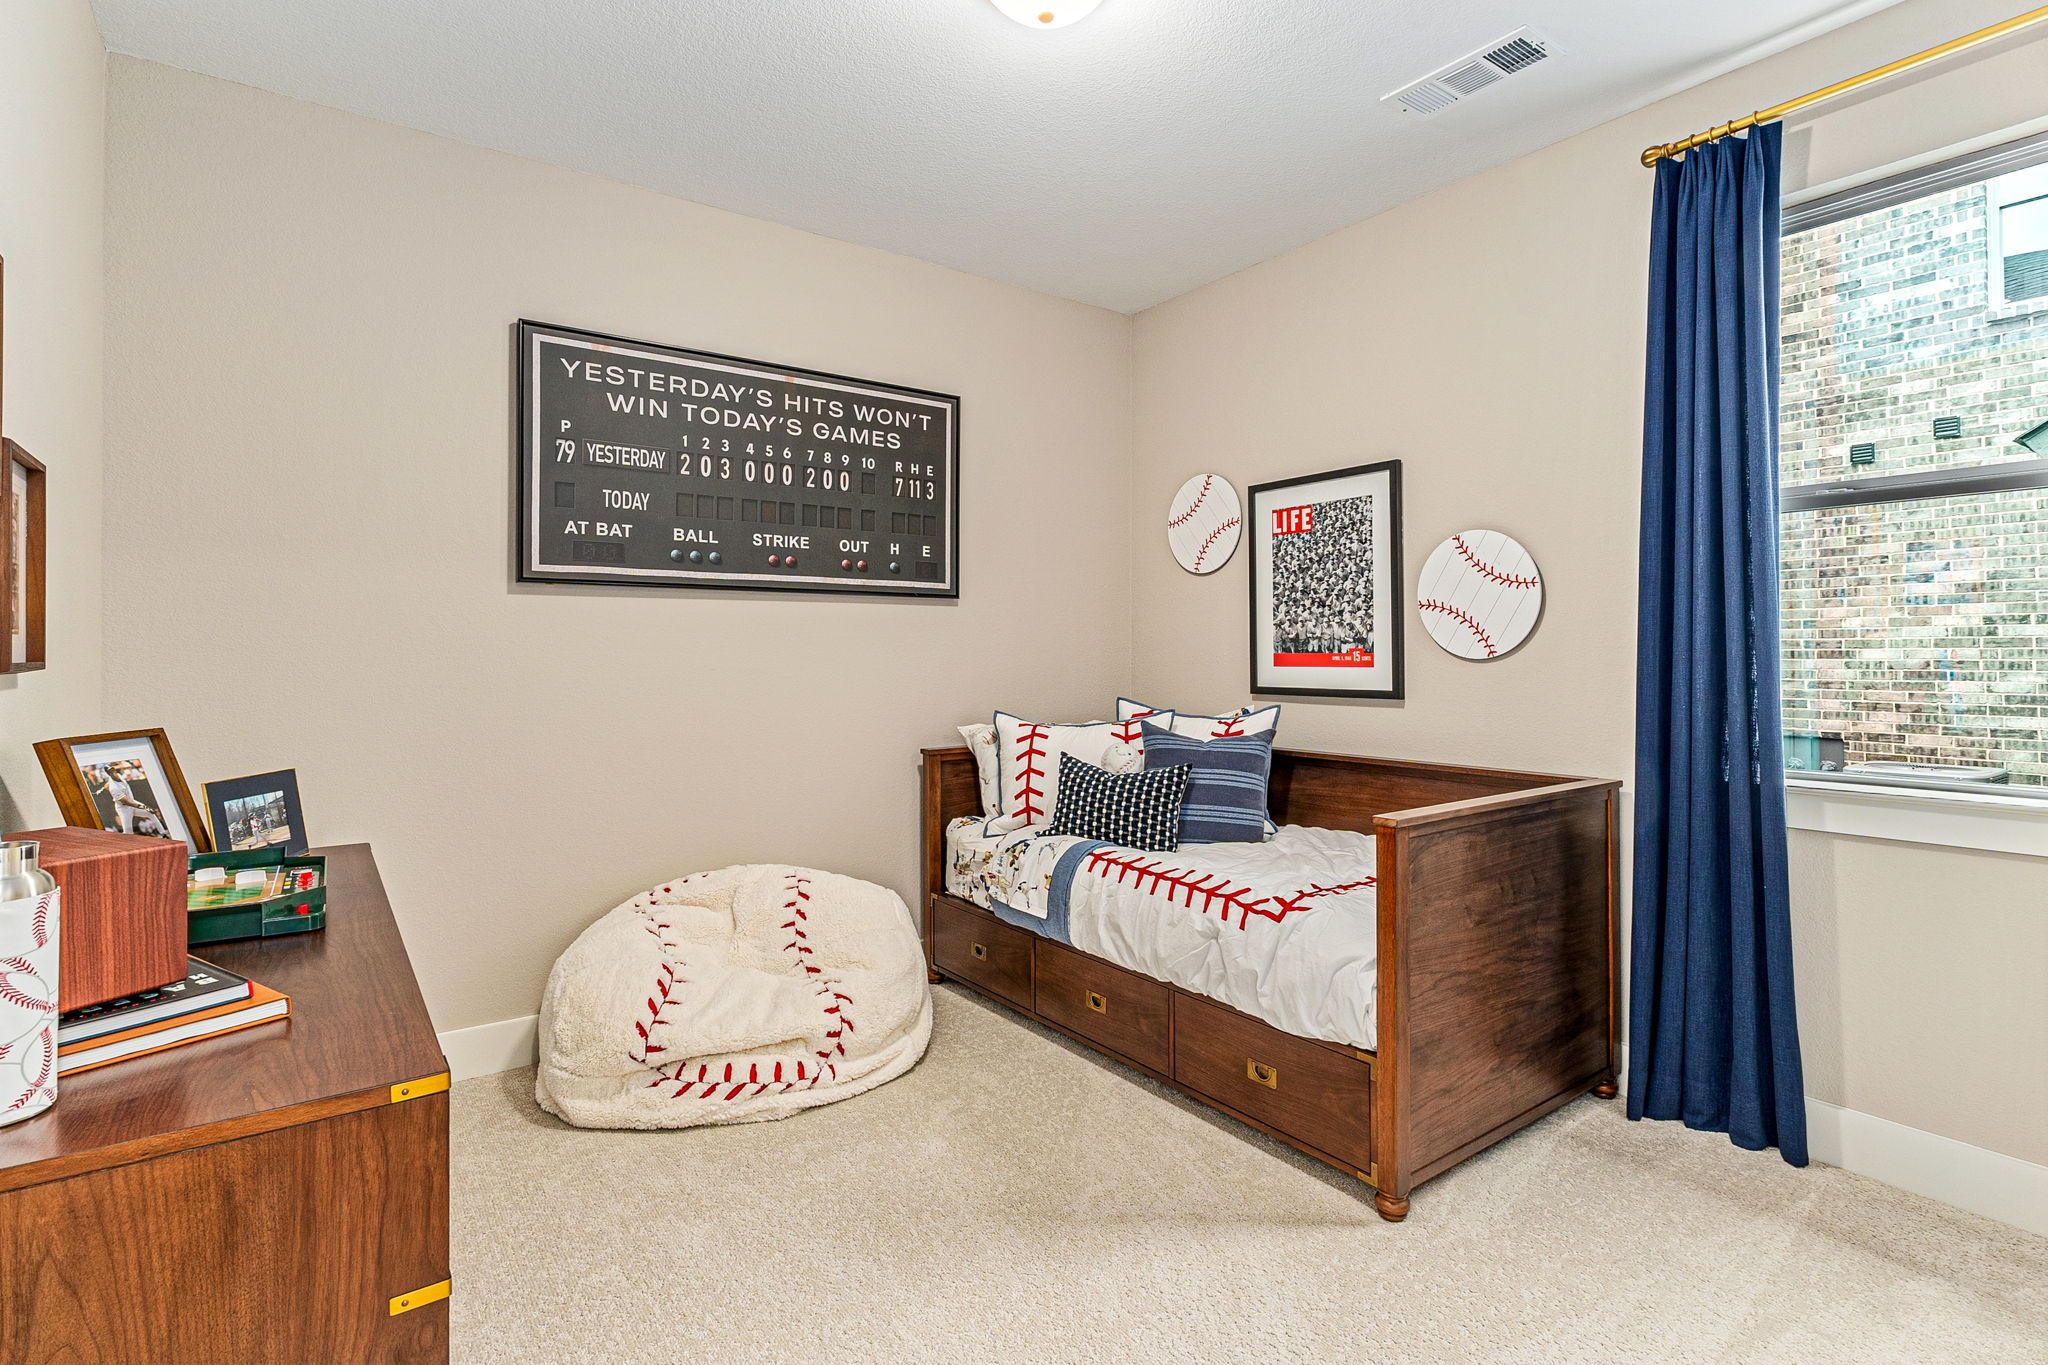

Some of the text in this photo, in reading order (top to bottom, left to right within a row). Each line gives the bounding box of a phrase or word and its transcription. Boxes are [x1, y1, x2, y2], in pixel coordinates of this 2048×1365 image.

[560, 357, 932, 432] YESTERDAY'S HITS WON'T
[605, 392, 901, 450] WIN TODAY'S GAMES
[560, 419, 934, 477] P 1 2 3 4 5 6 7 8 9 10 R H E
[555, 438, 934, 501] 79 YESTERDAY 2 0 3 0 0 0 2 0 0 7 11 3
[602, 488, 651, 512] TODAY
[564, 520, 634, 538] AT BAT
[1272, 508, 1312, 534] LIFE
[673, 527, 719, 544] BALL
[752, 532, 811, 550] STRIKE
[839, 539, 870, 554] OUT
[890, 542, 900, 556] H
[922, 545, 931, 558] E
[1353, 651, 1361, 662] 15
